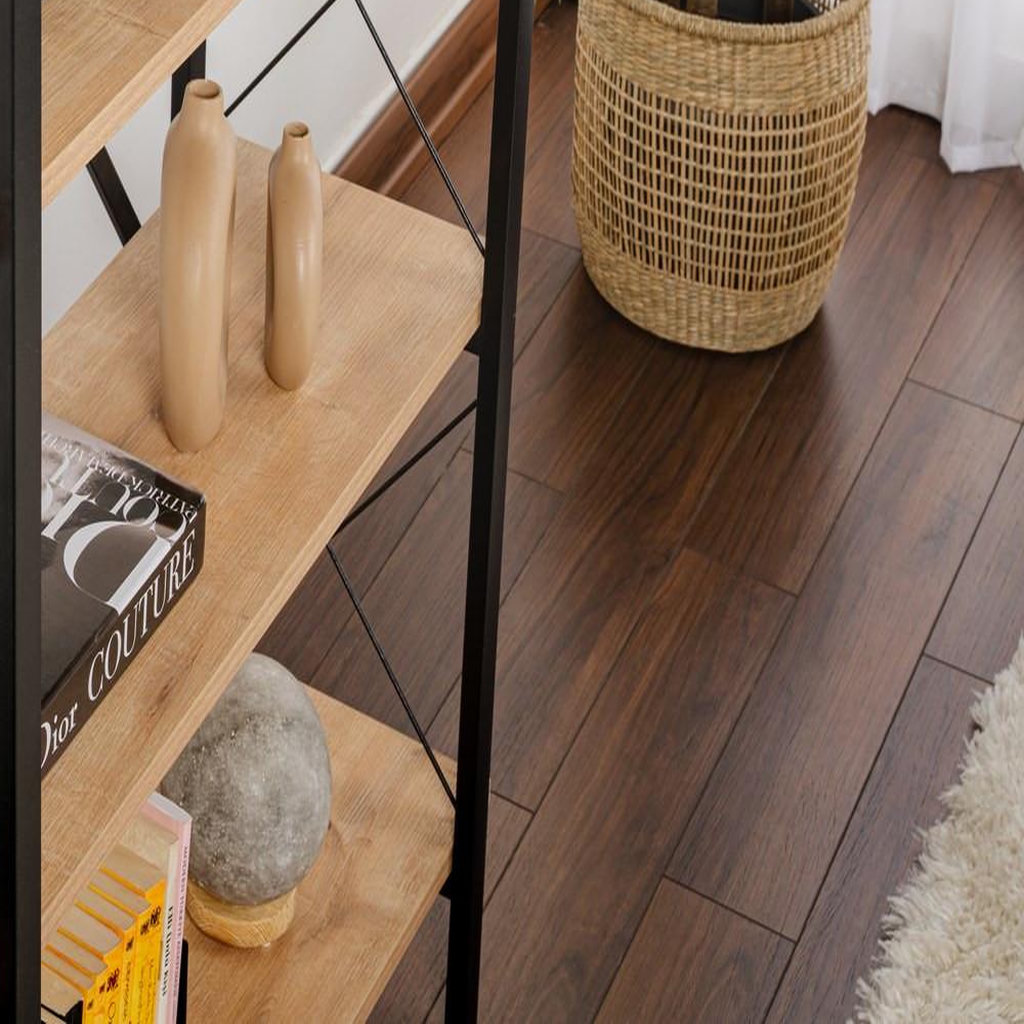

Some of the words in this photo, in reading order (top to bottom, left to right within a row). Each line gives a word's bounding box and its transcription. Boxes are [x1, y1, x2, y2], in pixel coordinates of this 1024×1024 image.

[41, 433, 126, 484] DEMARCH
[127, 475, 198, 524] PATRICK
[88, 529, 196, 701] COUTURE
